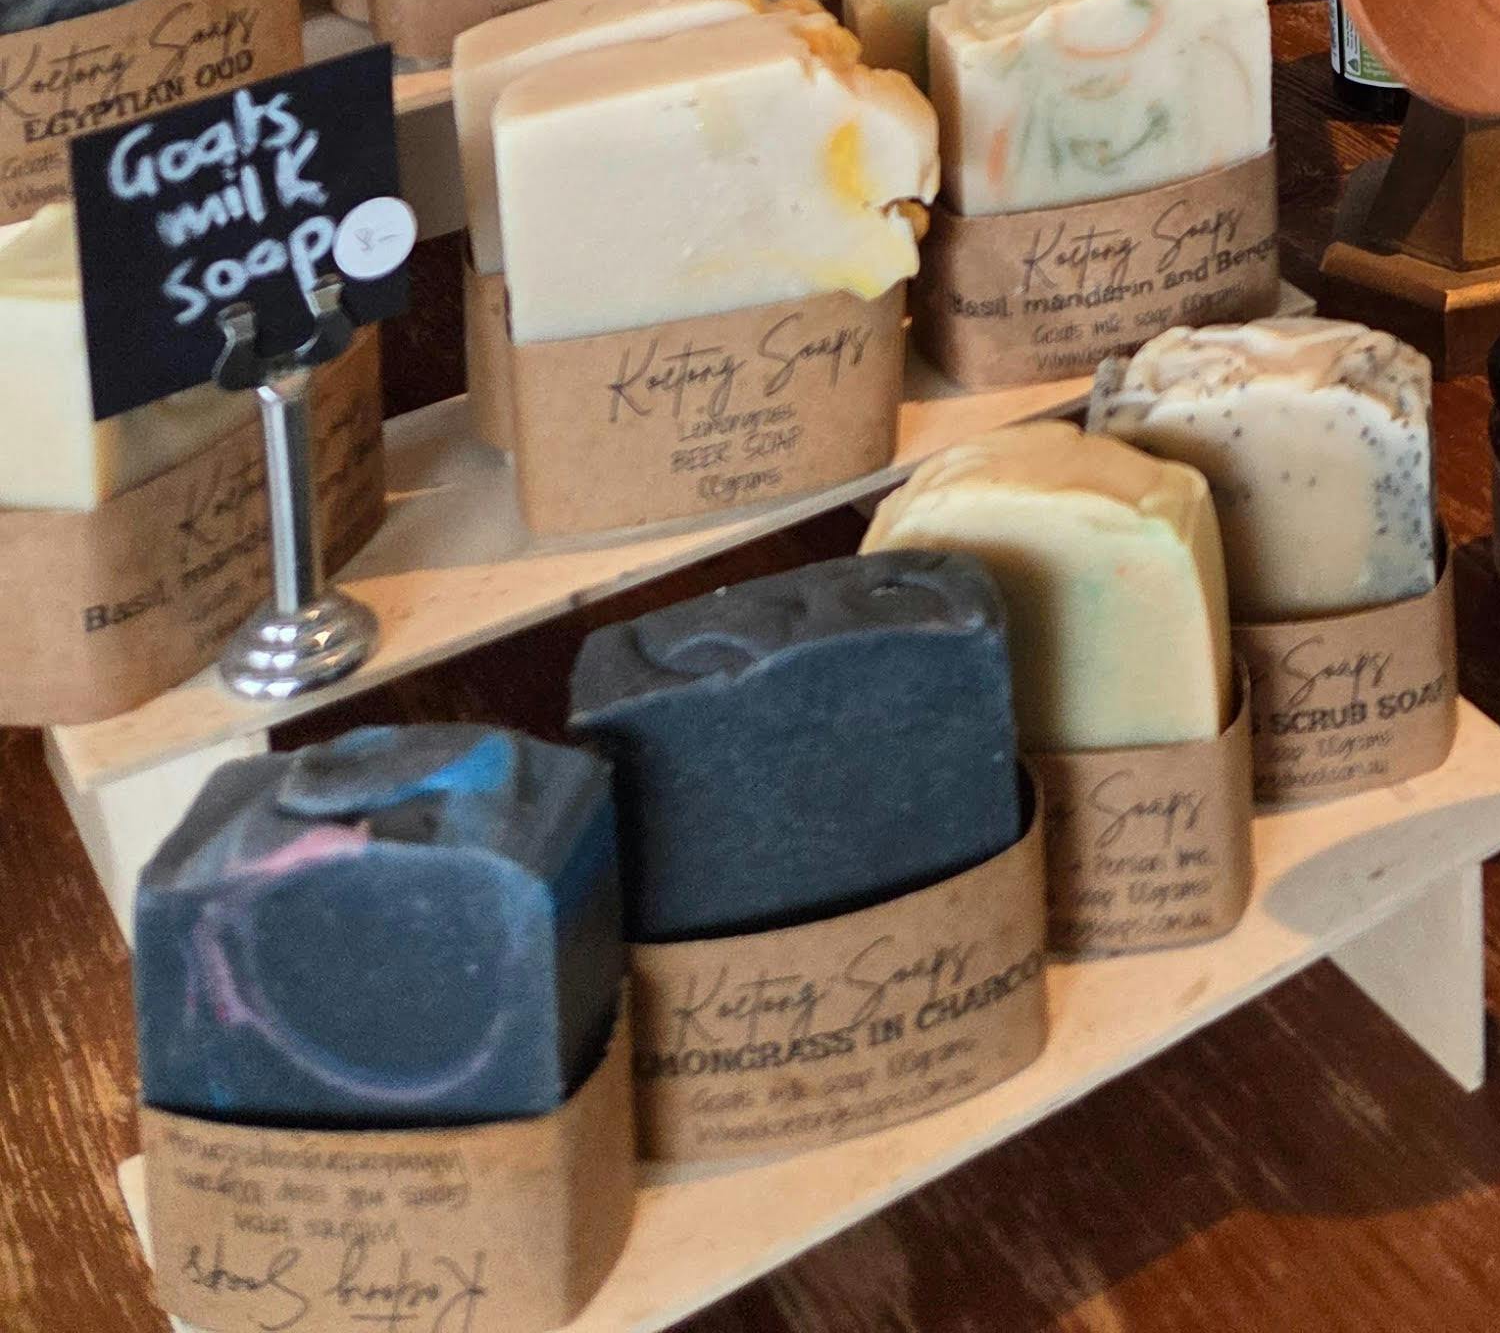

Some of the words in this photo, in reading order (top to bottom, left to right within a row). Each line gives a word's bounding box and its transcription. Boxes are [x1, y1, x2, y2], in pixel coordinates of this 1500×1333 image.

[22, 80, 185, 143] EGYPTIAN
[194, 49, 254, 88] OUD
[107, 88, 299, 200] Goats
[156, 129, 329, 247] milk
[163, 215, 338, 325] soap
[1024, 278, 1154, 316] mandarin
[1163, 261, 1211, 290] and
[671, 438, 736, 474] BEER
[1271, 701, 1368, 735] SCRUB
